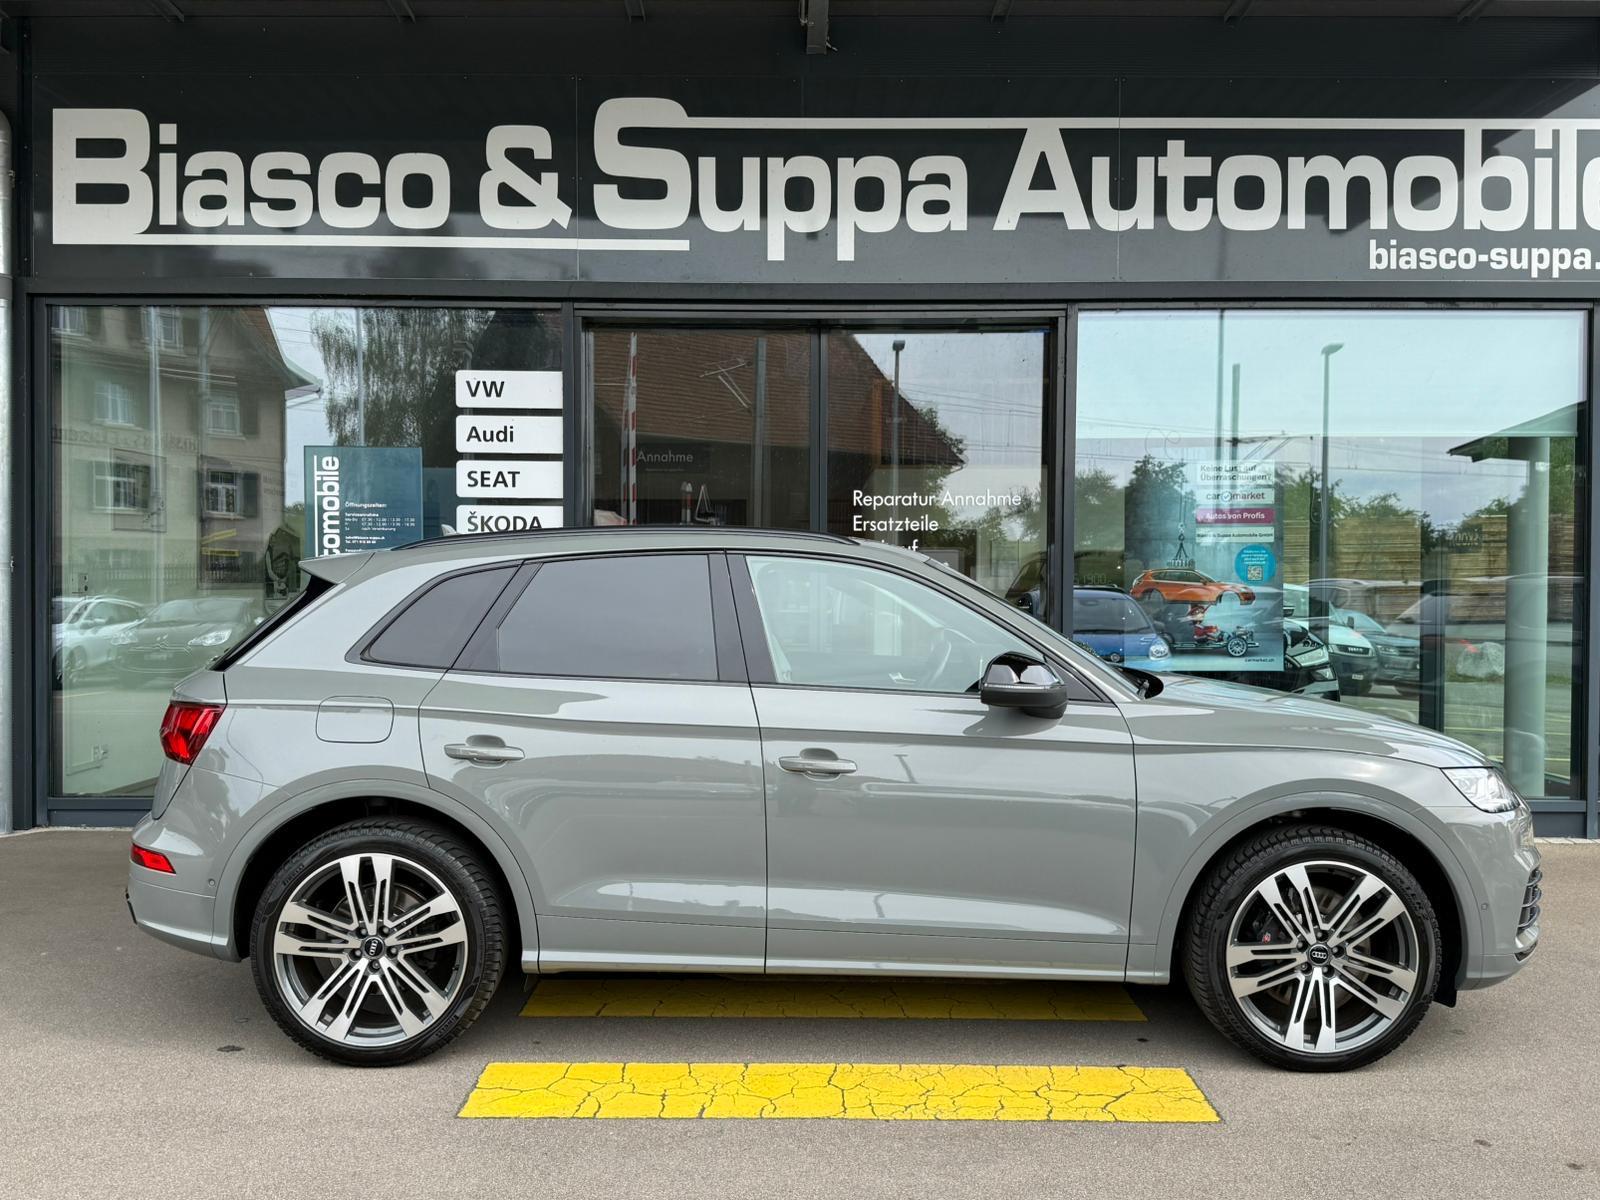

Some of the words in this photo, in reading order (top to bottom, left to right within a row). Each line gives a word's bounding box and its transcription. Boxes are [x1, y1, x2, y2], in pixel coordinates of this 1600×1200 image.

[53, 108, 451, 245] Biasco
[479, 125, 573, 230] &
[593, 97, 968, 262] Suppa
[994, 117, 1600, 232] Automobil
[466, 380, 505, 398] VW
[466, 425, 515, 443] Audi
[636, 448, 694, 463] Annahme
[1200, 464, 1223, 473] Keine
[1200, 472, 1272, 482] Überraschungen?
[466, 470, 521, 488] SEAT
[853, 489, 935, 510] Reparatur
[941, 488, 1022, 507] Annahme
[467, 510, 543, 532] ŠKODA
[853, 514, 939, 532] Ersatzteile
[1205, 512, 1227, 521] Autos
[1228, 513, 1242, 521] von
[1243, 511, 1265, 521] Profis
